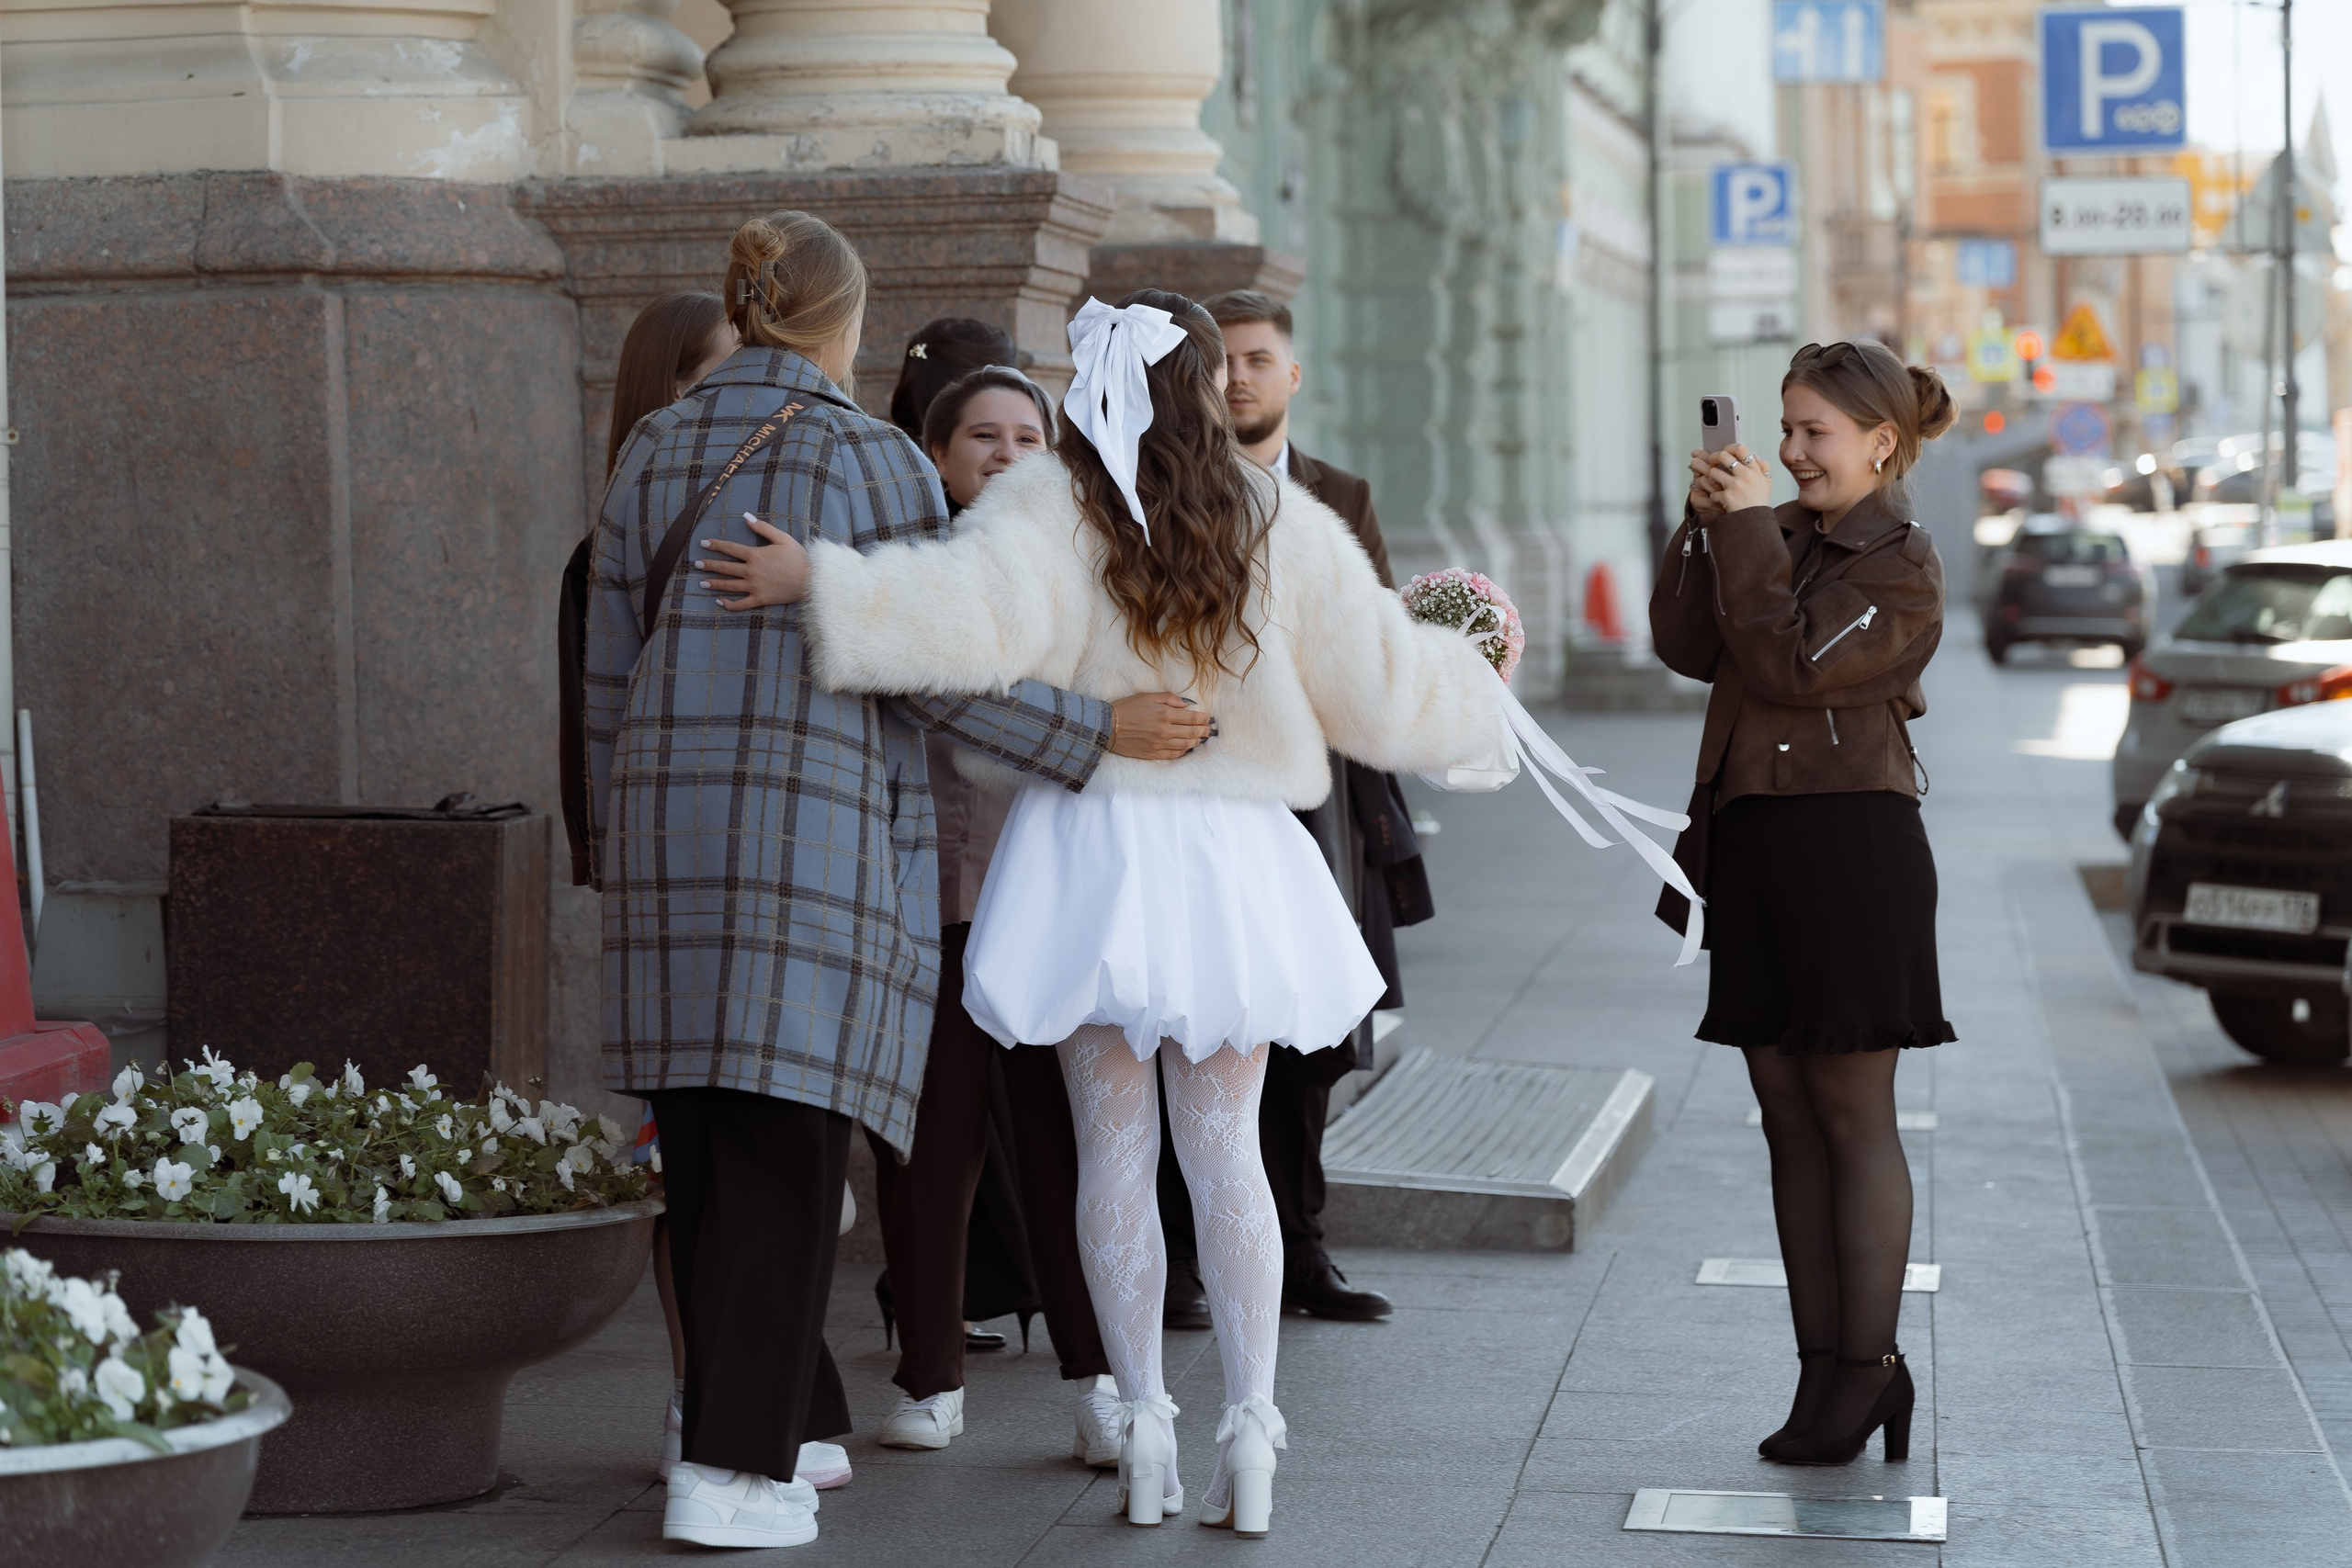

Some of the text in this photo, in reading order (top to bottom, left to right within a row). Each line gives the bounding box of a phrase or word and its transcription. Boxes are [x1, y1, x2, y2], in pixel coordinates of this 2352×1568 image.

[2080, 19, 2163, 140] P
[1729, 172, 1781, 236] P
[719, 401, 805, 481] MK MICHAEL
